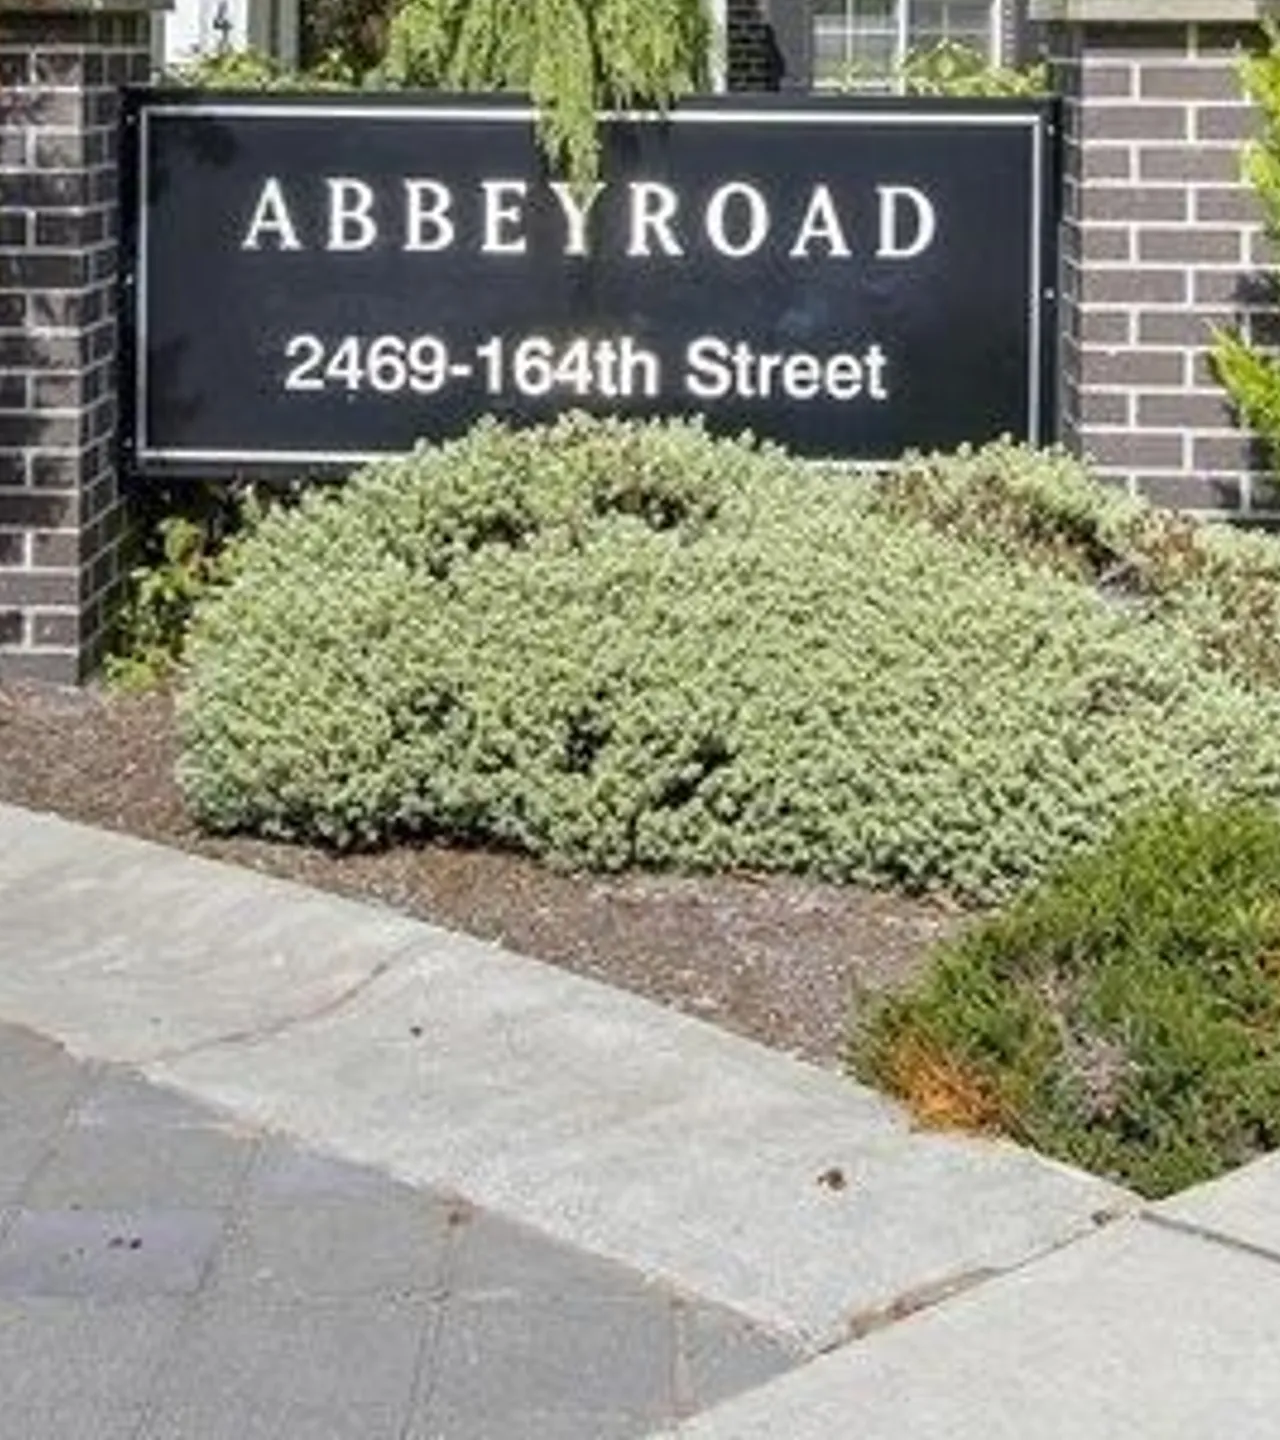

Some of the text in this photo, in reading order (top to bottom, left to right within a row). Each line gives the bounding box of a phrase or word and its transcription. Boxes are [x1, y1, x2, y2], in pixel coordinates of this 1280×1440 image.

[241, 177, 937, 259] ABBEYROAD
[284, 334, 888, 401] 2469-164th Street
